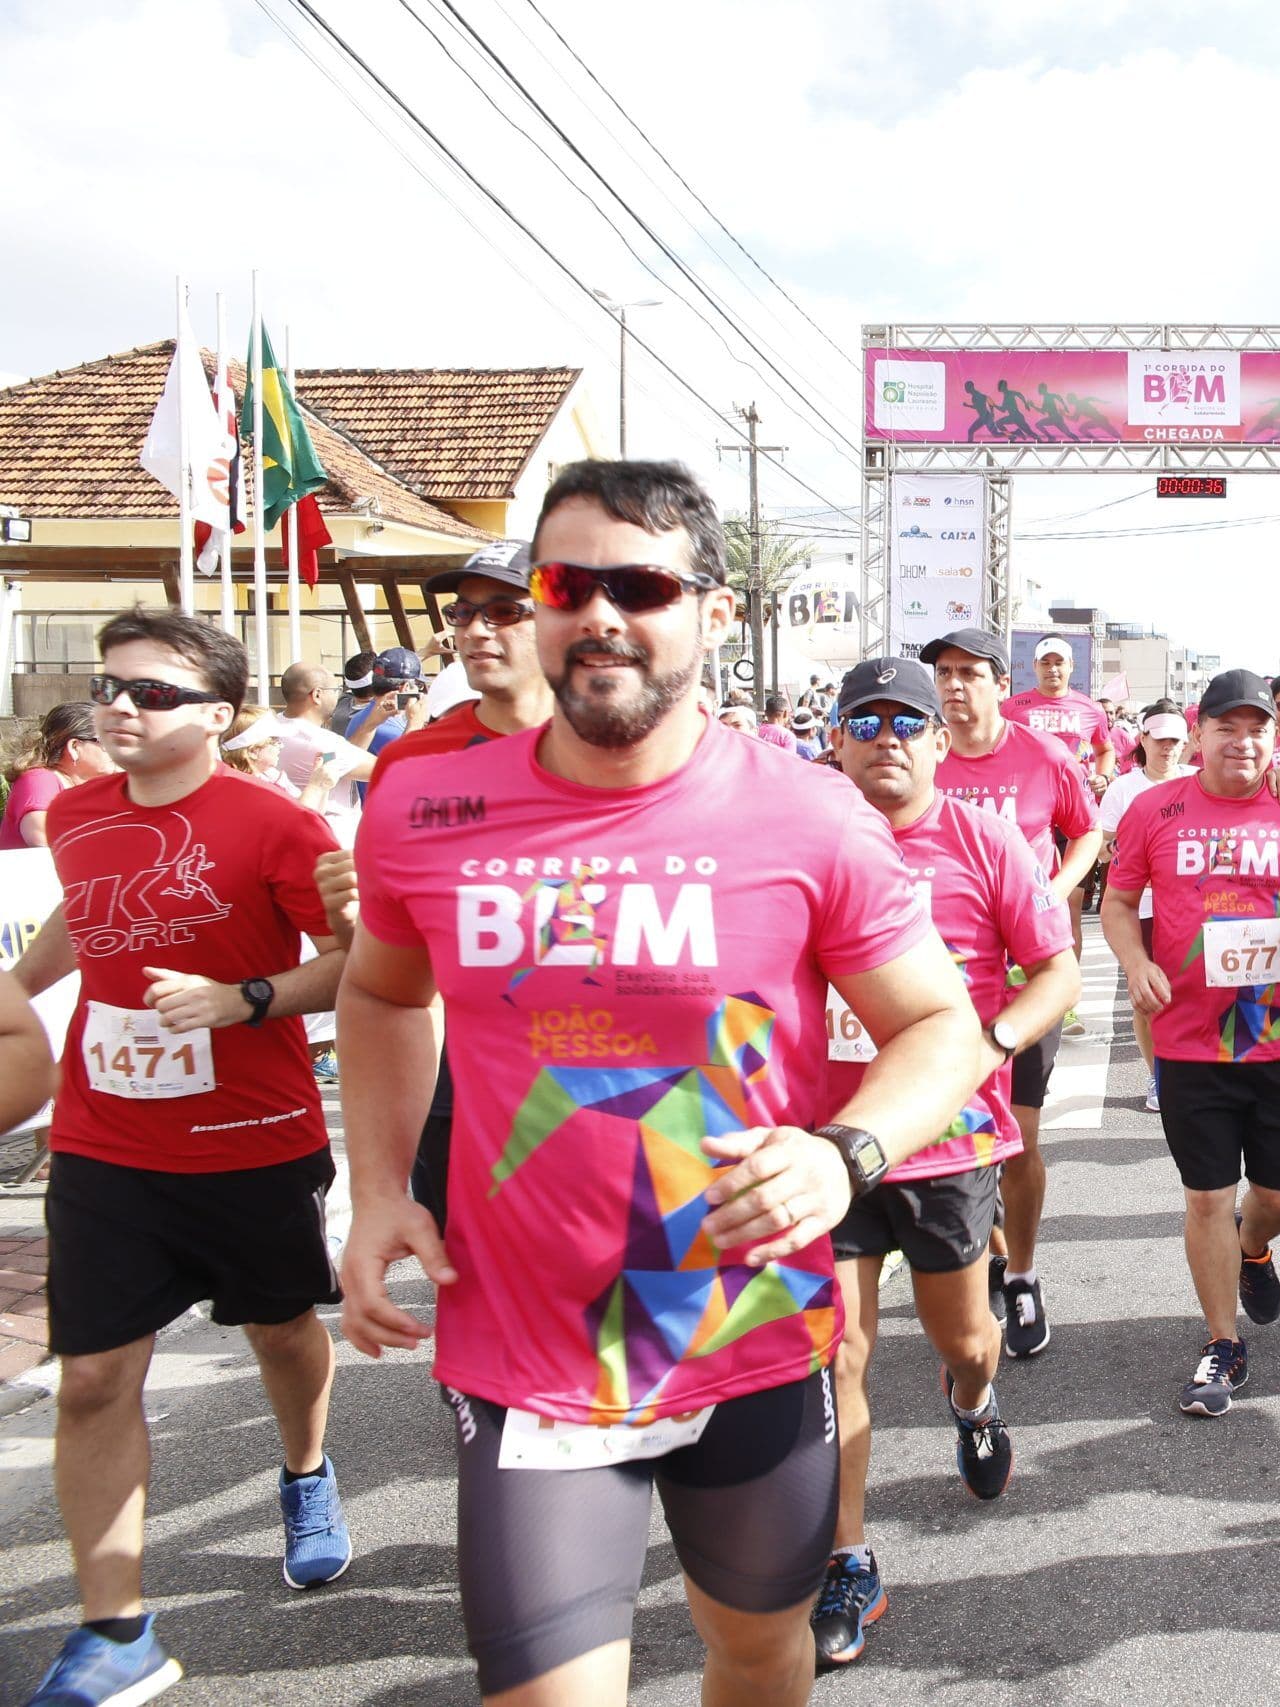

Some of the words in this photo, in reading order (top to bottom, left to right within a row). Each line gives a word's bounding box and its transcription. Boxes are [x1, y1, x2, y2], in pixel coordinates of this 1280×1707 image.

[1144, 374, 1226, 402] BEM
[1144, 428, 1224, 440] CHEGADA
[1158, 478, 1222, 494] 00:00:36
[955, 497, 975, 505] hnsn
[940, 532, 976, 540] CAIXA
[938, 786, 990, 798] ORRIDA
[999, 786, 1018, 794] DO
[1177, 828, 1248, 839] CORRIDA
[1258, 830, 1280, 839] DO
[460, 856, 638, 878] CORRIDA
[665, 856, 719, 876] DO
[1176, 840, 1280, 877] BEM
[1204, 902, 1256, 913] PESSOA
[456, 883, 719, 968] BEM
[1221, 946, 1278, 972] 677
[682, 974, 711, 983] sua
[530, 1004, 614, 1033] JOÃO
[528, 1032, 659, 1060] PESSOA
[90, 1042, 196, 1079] 1471
